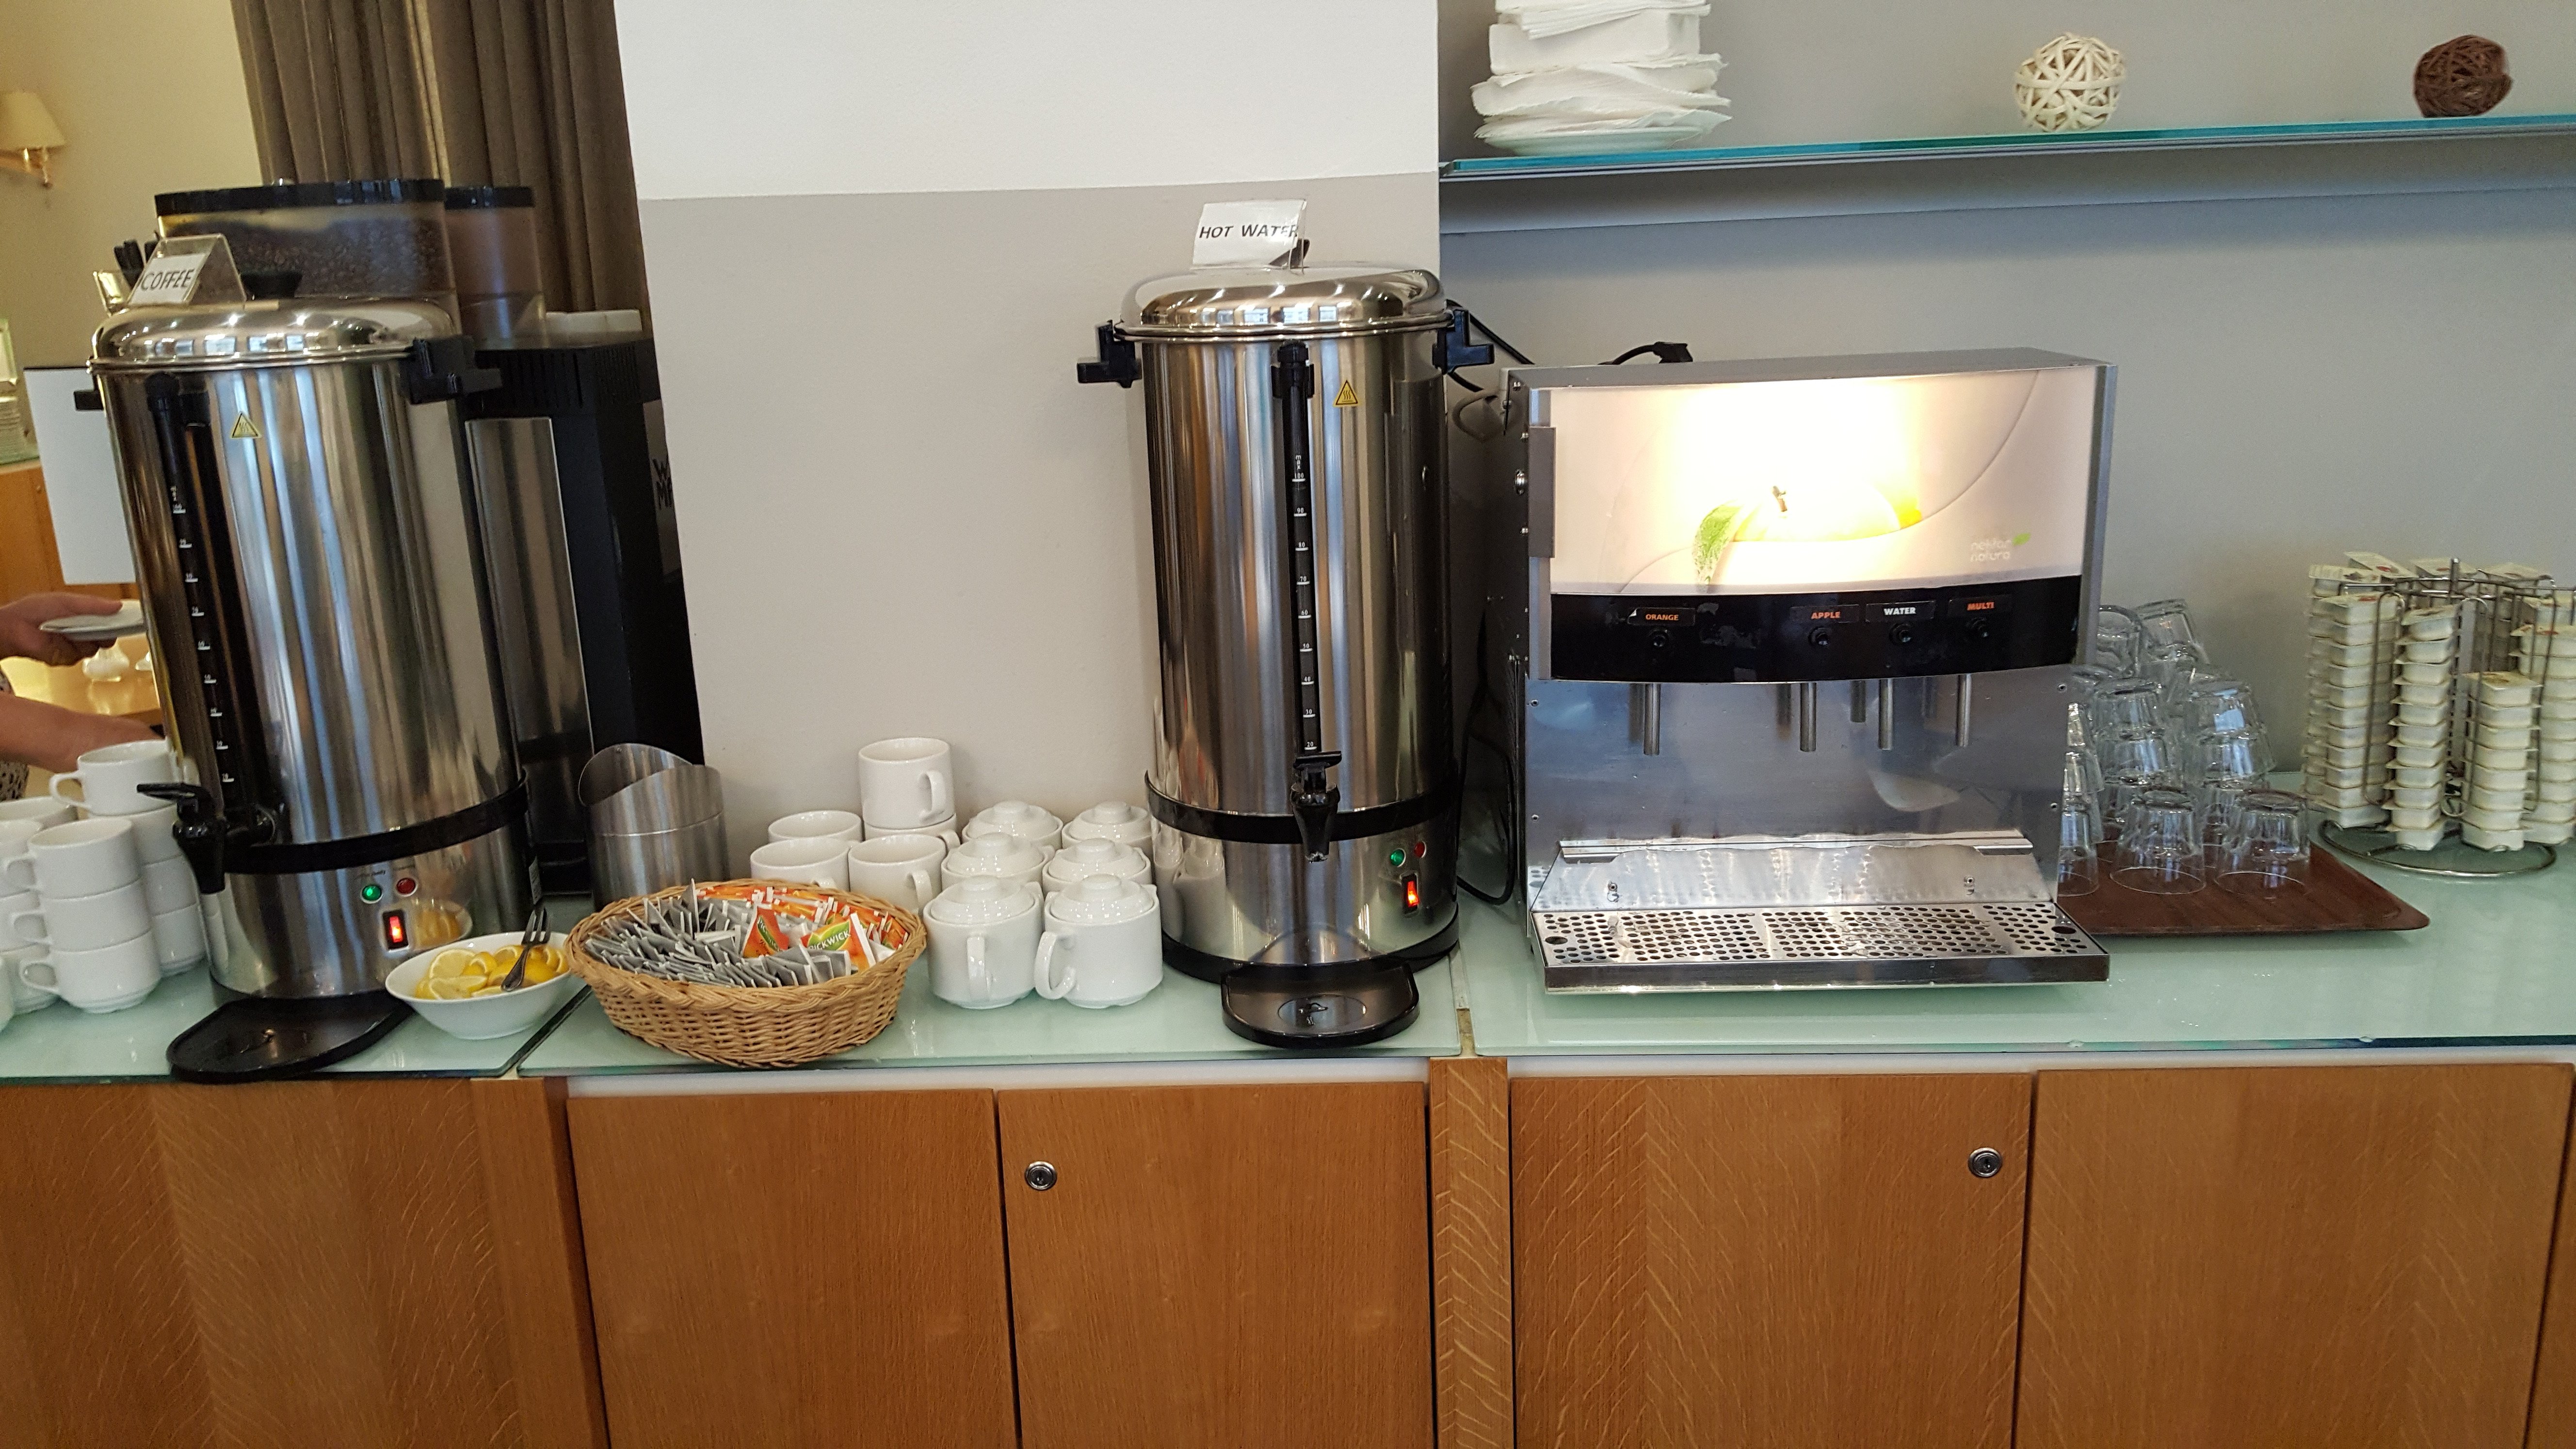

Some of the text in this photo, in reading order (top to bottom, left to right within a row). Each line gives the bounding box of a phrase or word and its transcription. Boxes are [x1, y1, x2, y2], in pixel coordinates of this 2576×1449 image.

[1199, 224, 1299, 239] HOT WATER
[141, 268, 195, 290] COFFEE
[1883, 606, 1916, 615] WATER
[1966, 601, 1995, 611] MULTI
[1810, 611, 1841, 620] APPLE
[808, 930, 851, 950] PICKWICK
